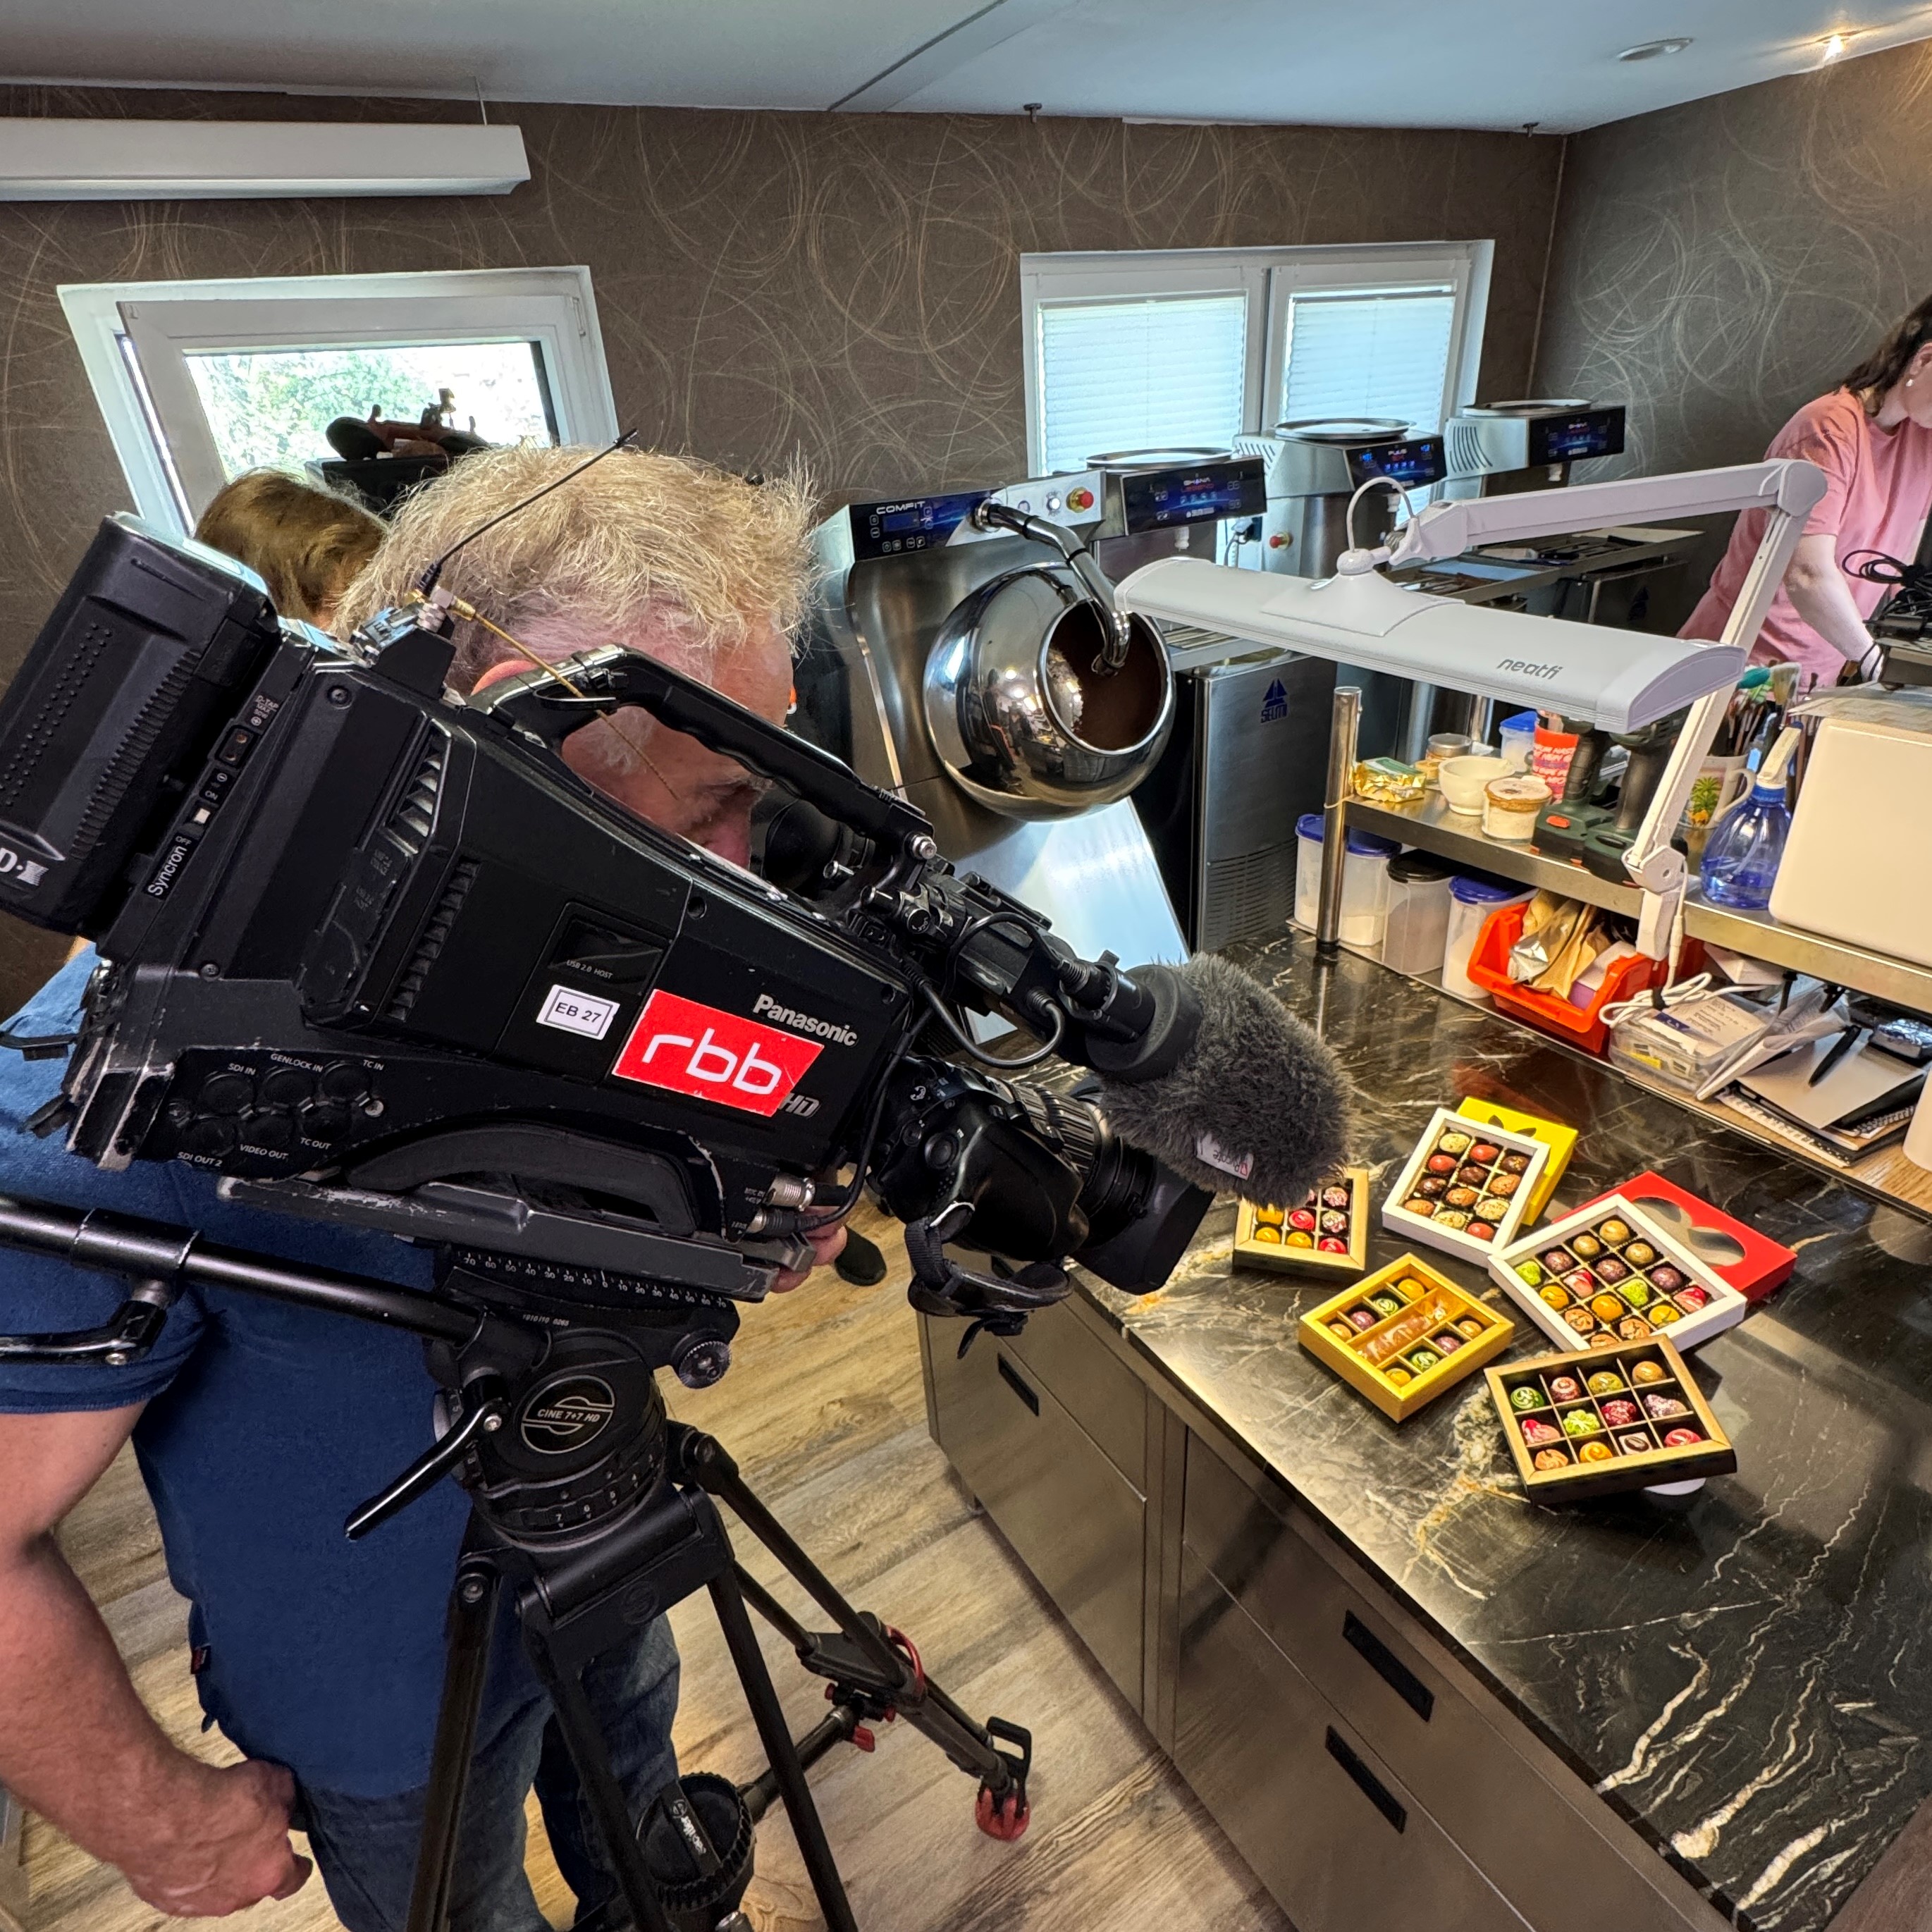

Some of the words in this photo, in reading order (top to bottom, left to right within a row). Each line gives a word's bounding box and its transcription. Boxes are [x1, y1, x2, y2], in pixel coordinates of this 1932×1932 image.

[875, 500, 925, 515] COMFIT
[1496, 658, 1564, 680] neatfi
[204, 790, 218, 801] ON
[176, 835, 192, 846] OFF
[147, 845, 187, 897] Syncron
[566, 959, 581, 969] USB
[581, 964, 592, 973] 2.0
[593, 968, 613, 979] HOST
[555, 1002, 579, 1016] EB
[582, 1010, 602, 1023] 27
[753, 993, 858, 1046] Panasonic
[270, 1053, 312, 1070] GENLOCK
[313, 1064, 324, 1073] IN
[374, 1062, 385, 1071] IN
[641, 1027, 782, 1095] rbb
[227, 1063, 244, 1073] SDI
[245, 1066, 256, 1076] IN
[300, 1137, 312, 1145] TC
[312, 1140, 331, 1150] OUT
[177, 1151, 193, 1161] SDI
[194, 1155, 215, 1166] OUT
[215, 1159, 223, 1167] 2
[240, 1144, 267, 1157] VIDEO
[269, 1150, 289, 1159] OUT
[537, 1408, 564, 1420] CINE
[584, 1413, 601, 1422] HD
